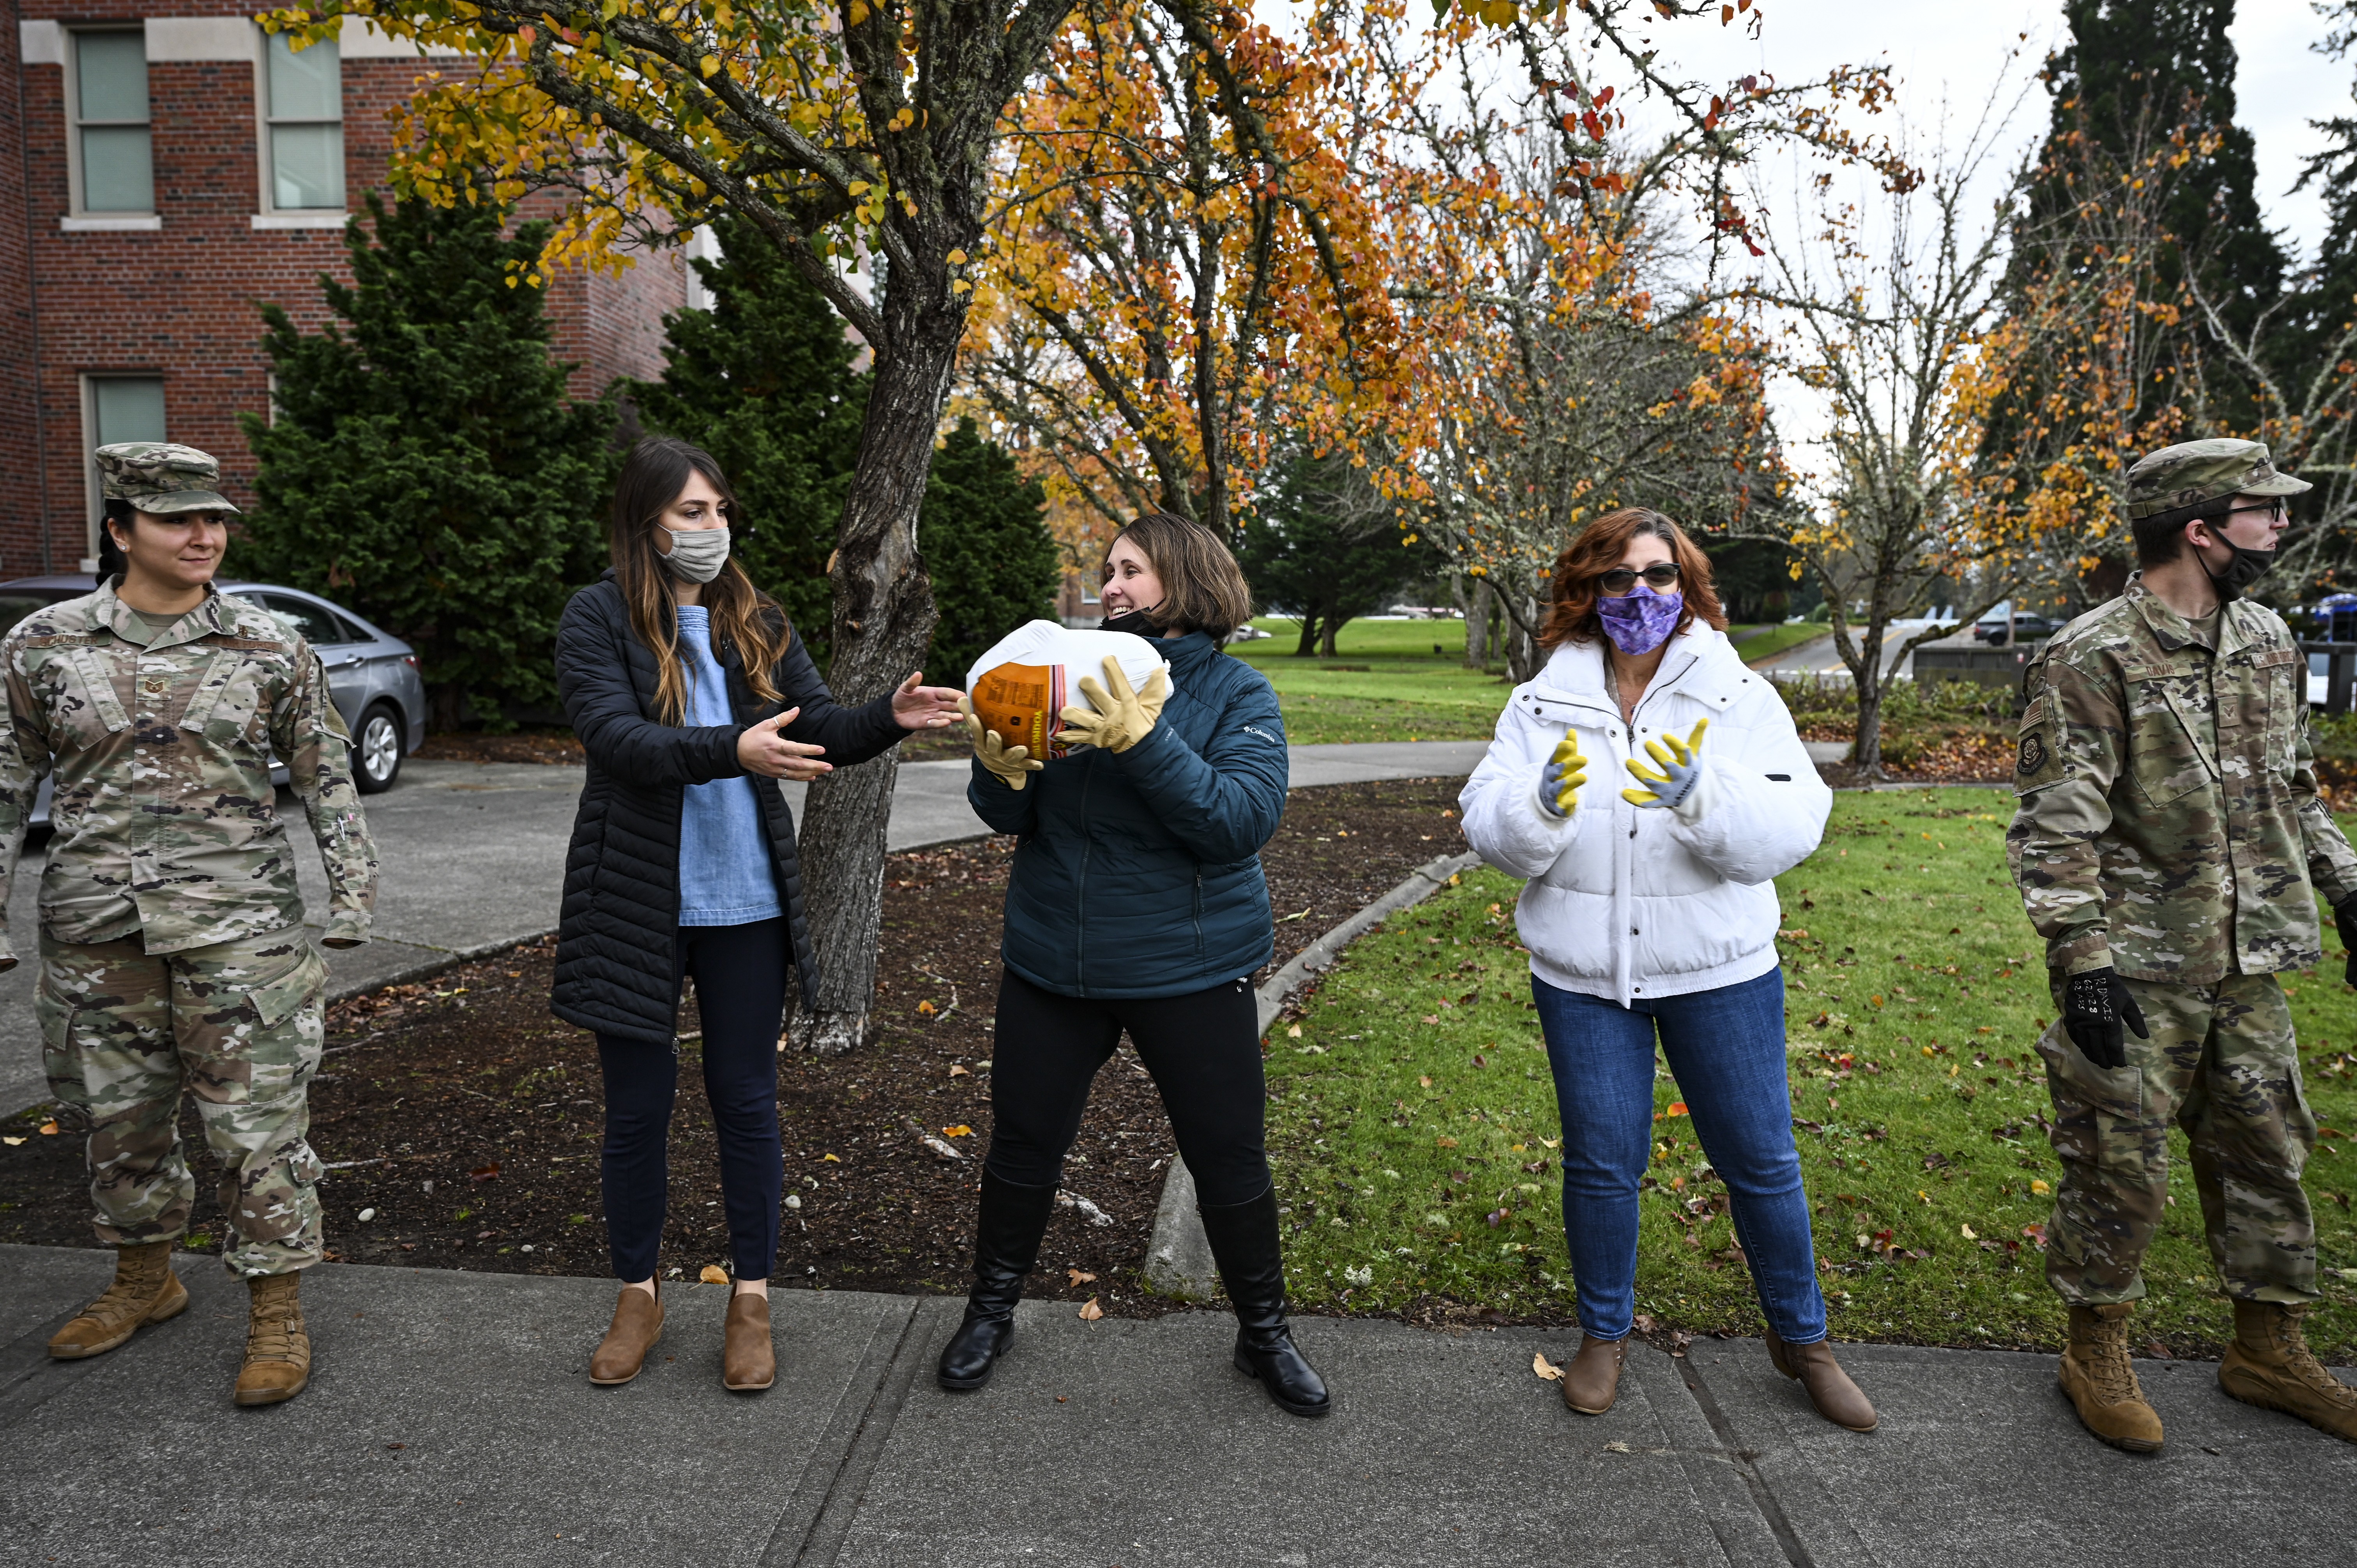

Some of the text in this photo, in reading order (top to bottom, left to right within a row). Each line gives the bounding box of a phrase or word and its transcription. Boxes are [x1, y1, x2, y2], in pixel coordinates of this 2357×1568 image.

[40, 635, 98, 647] SCHUSTER
[2146, 664, 2175, 676] DAVIS
[1032, 710, 1043, 743] YOUNG
[1250, 727, 1275, 743] Columbia
[2074, 980, 2085, 1010] 62 APS
[2084, 980, 2098, 1013] 62028
[2097, 988, 2113, 1022] DAVIS
